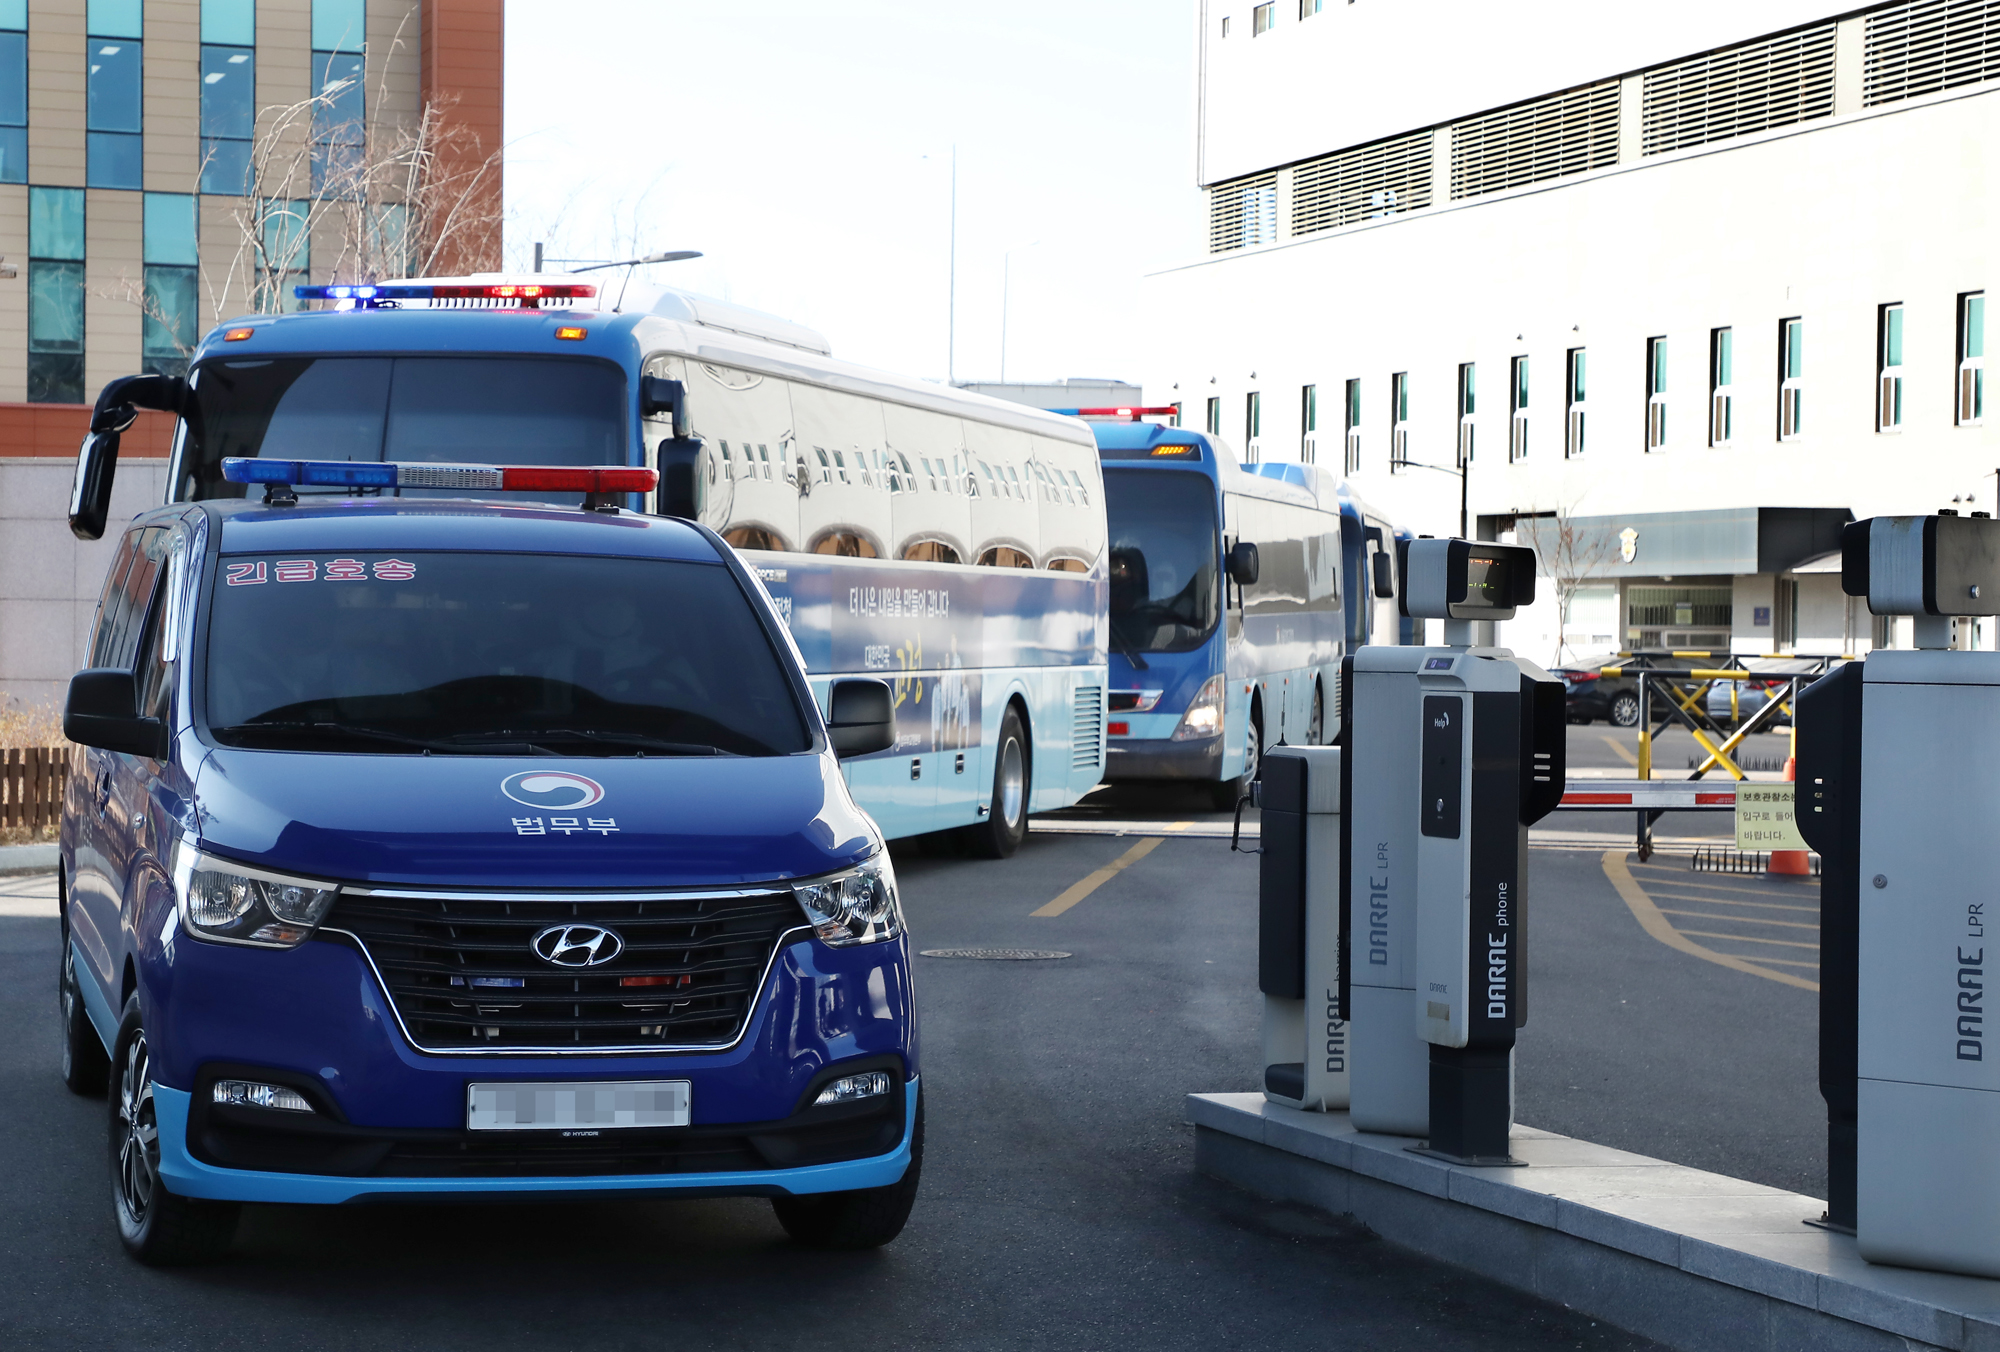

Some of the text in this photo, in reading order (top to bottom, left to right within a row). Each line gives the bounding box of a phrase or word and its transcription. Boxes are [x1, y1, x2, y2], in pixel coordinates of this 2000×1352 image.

[226, 558, 416, 586] 긴급호송
[850, 587, 949, 618] 더 나은 내일을 만들어 갑니다
[865, 645, 890, 669] 대한민국
[1434, 717, 1446, 729] Help
[511, 817, 620, 836] 법무부
[1743, 812, 1770, 821] 입구로
[1744, 831, 1786, 841] 바랍니다.
[1369, 841, 1388, 966] DARAE LPR
[1487, 882, 1509, 1018] DARAE phone
[1429, 982, 1447, 994] DARAE
[1956, 903, 1984, 1061] DARAE LPR
